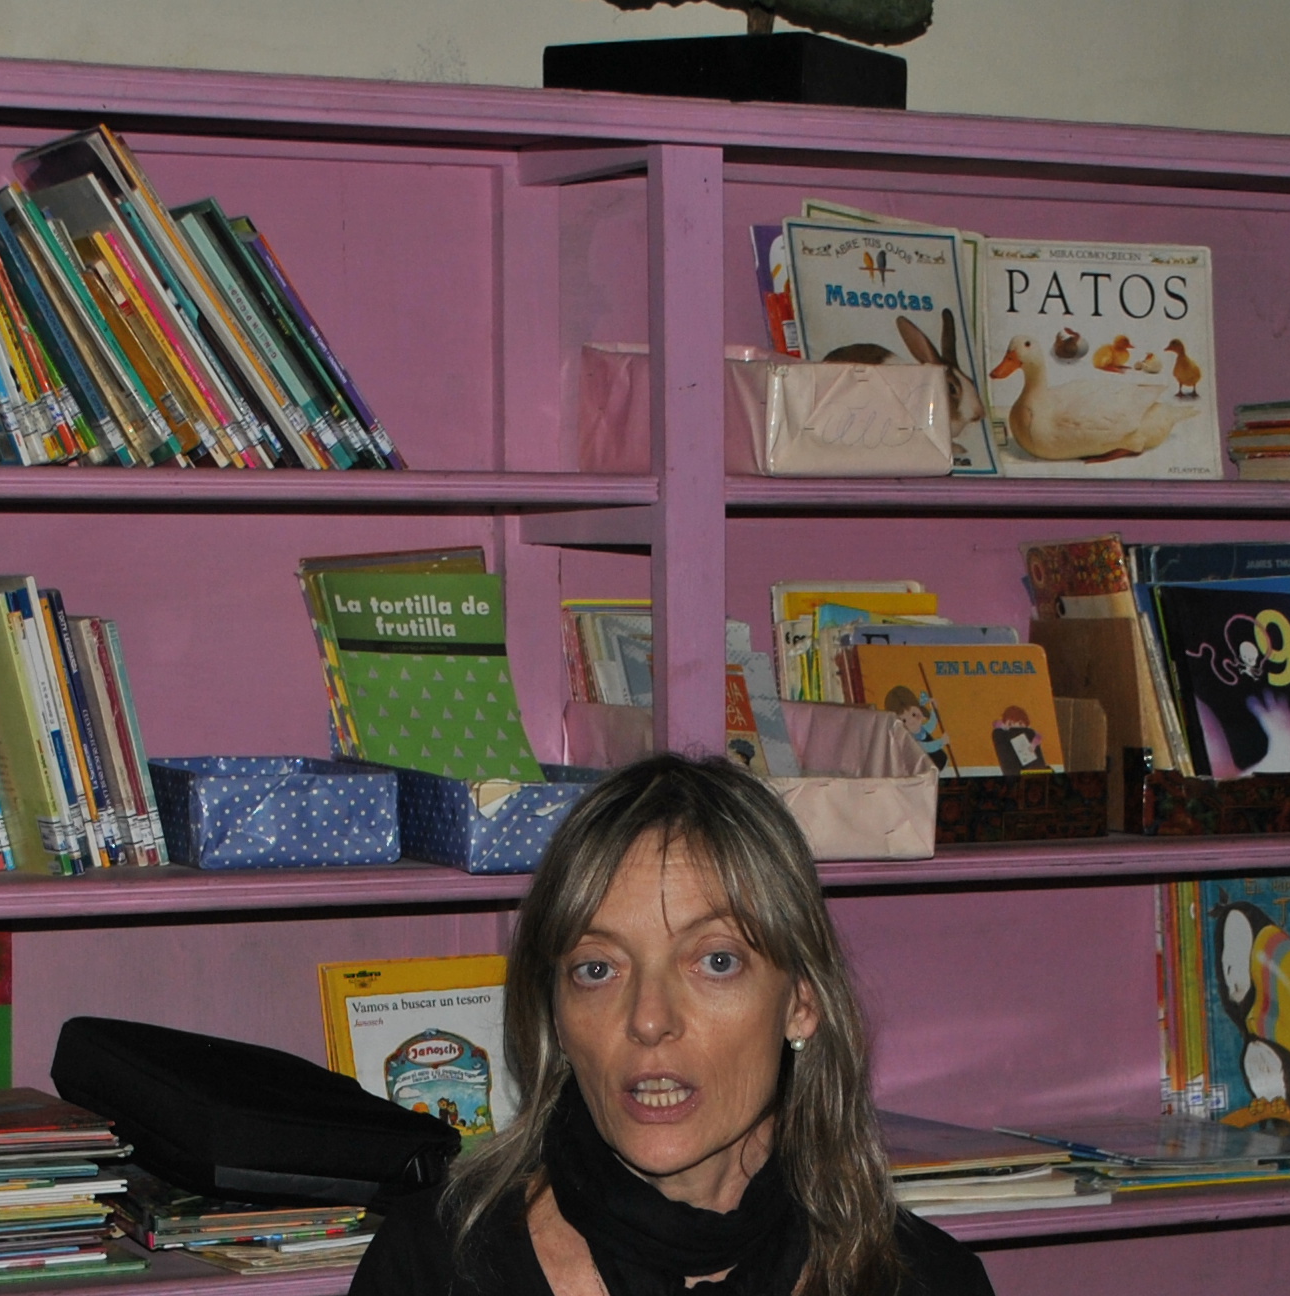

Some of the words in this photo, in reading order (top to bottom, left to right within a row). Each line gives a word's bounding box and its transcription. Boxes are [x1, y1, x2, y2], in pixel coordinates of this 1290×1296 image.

[834, 239, 860, 258] ABRE
[862, 237, 882, 251] TUS
[825, 283, 934, 313] Mascotas
[1005, 269, 1189, 320] PATOS
[1246, 559, 1273, 569] JAMES
[334, 594, 361, 614] La
[370, 595, 452, 615] tortilla
[461, 596, 489, 616] de
[375, 616, 456, 638] frutilla
[934, 661, 961, 675] EN
[963, 661, 987, 675] LA
[989, 661, 1037, 675] CASA
[1244, 880, 1264, 894] EL
[352, 1001, 389, 1013] Vamos
[392, 1003, 399, 1011] a
[401, 997, 436, 1010] buscar
[440, 997, 454, 1006] un
[456, 994, 490, 1006] tesoro
[411, 1045, 457, 1059] Janosch
